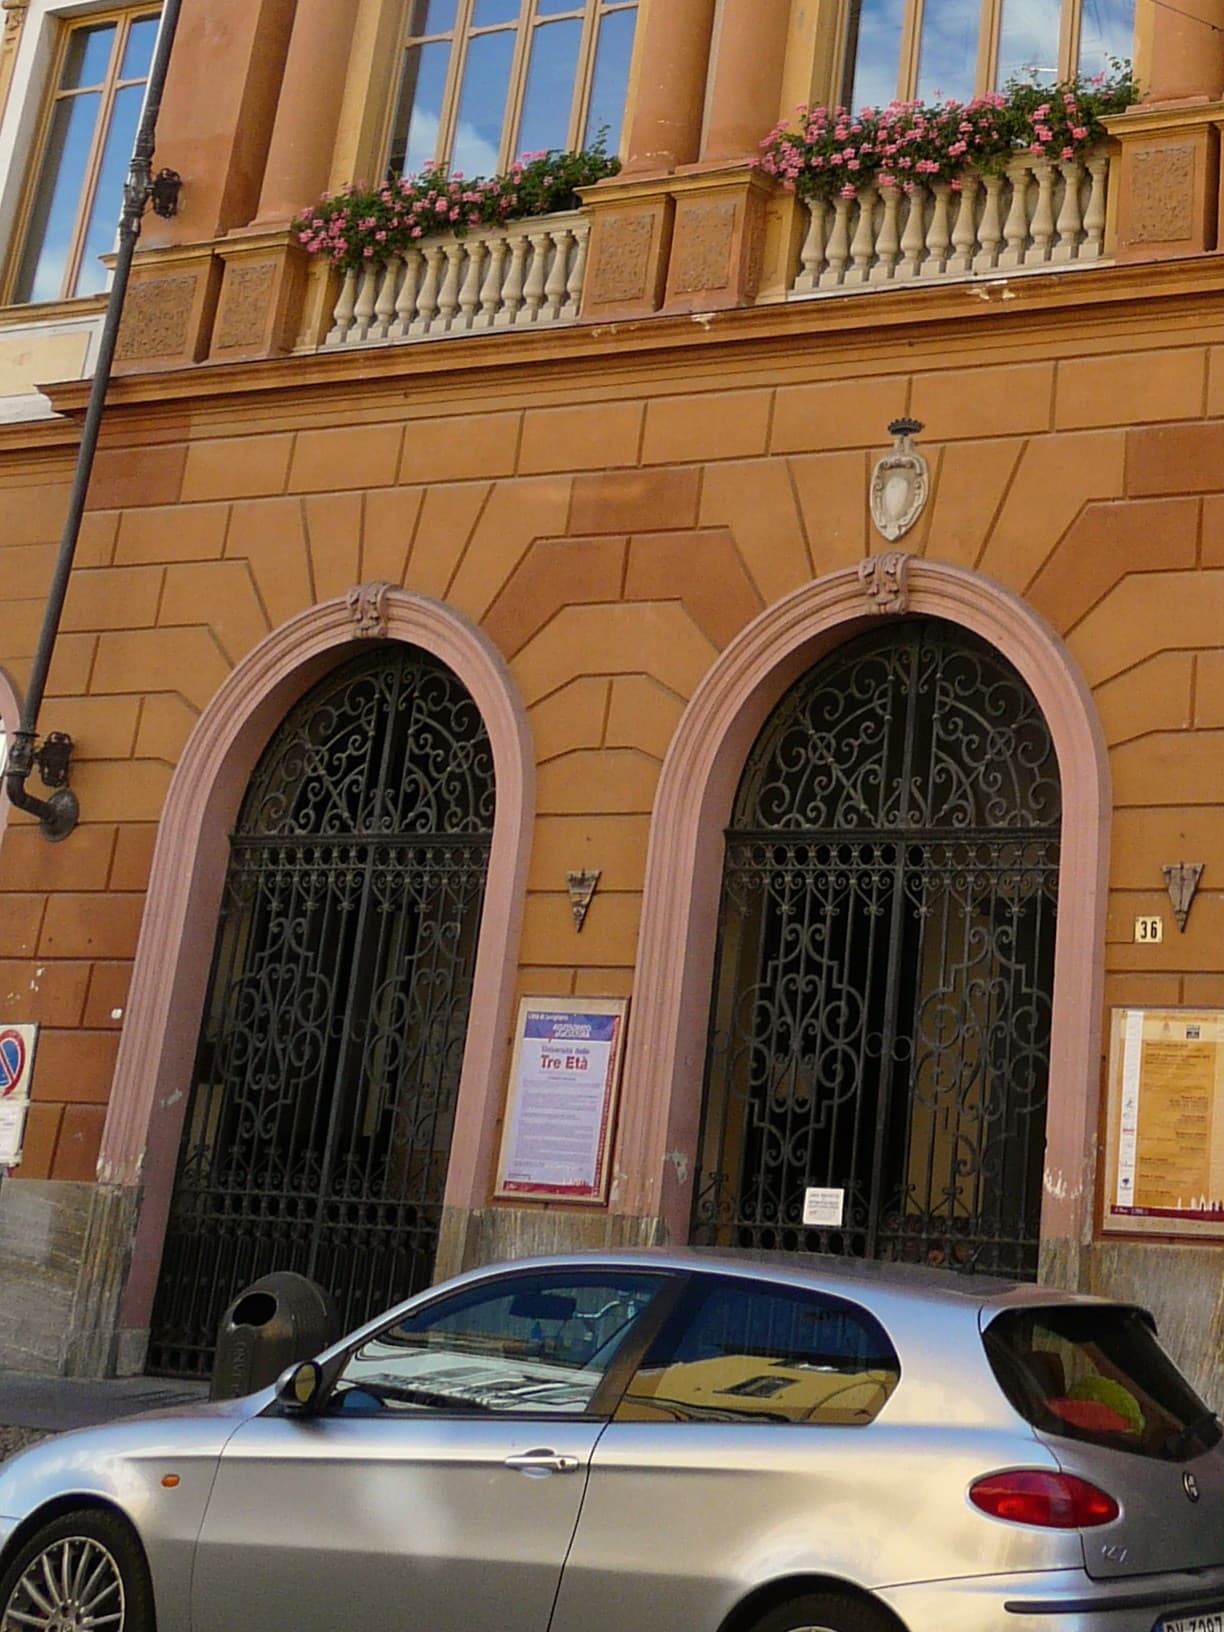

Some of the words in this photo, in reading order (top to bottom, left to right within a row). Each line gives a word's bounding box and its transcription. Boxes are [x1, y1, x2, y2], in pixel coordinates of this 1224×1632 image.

[1140, 920, 1158, 940] 36
[541, 1054, 561, 1069] Tre
[566, 1055, 588, 1070] Età
